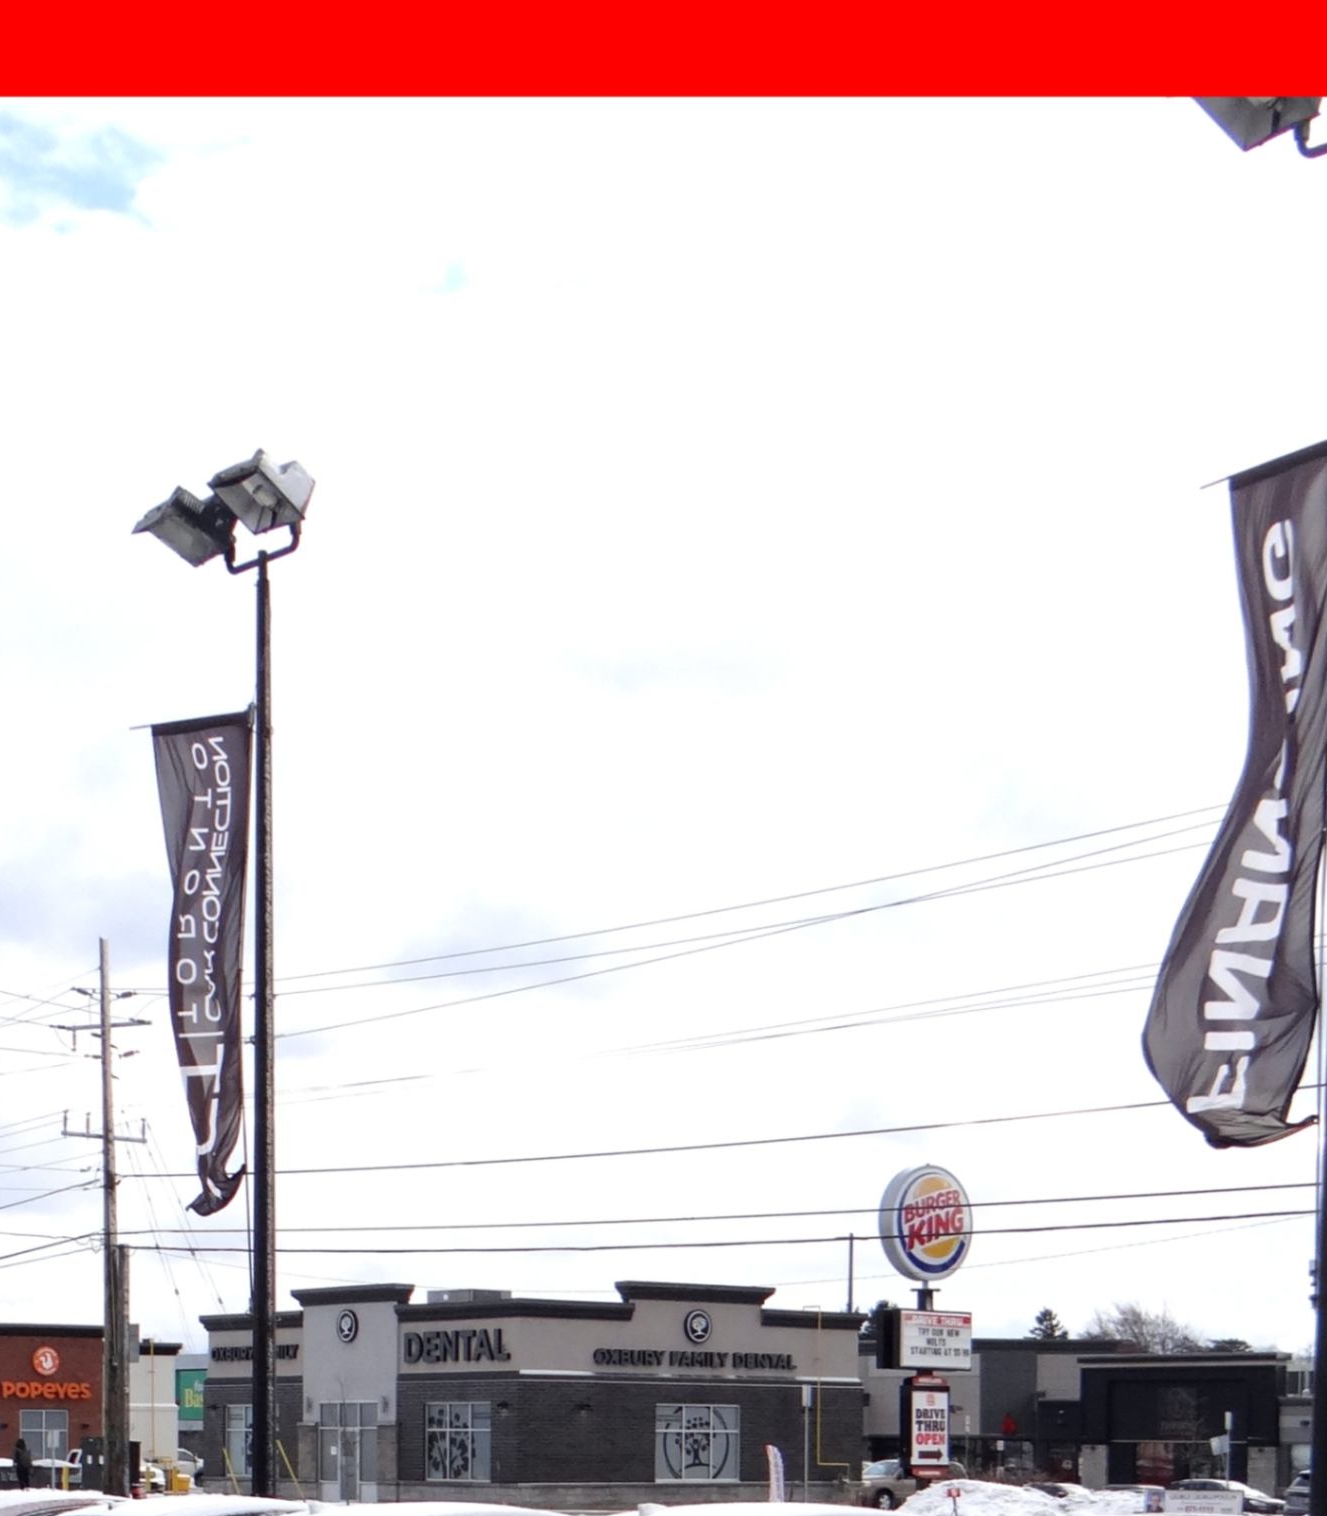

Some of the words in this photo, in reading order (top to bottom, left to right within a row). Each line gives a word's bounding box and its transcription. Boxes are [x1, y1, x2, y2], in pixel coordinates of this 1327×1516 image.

[903, 1189, 961, 1225] BURGER
[908, 1208, 964, 1250] KING
[404, 1328, 510, 1363] DENTAL
[593, 1348, 664, 1366] OXBURY
[669, 1350, 728, 1368] FAMILY
[732, 1352, 797, 1370] DENTAL
[915, 1408, 945, 1419] DRIVE
[915, 1420, 945, 1432] THRU
[916, 1433, 945, 1445] OPEN
